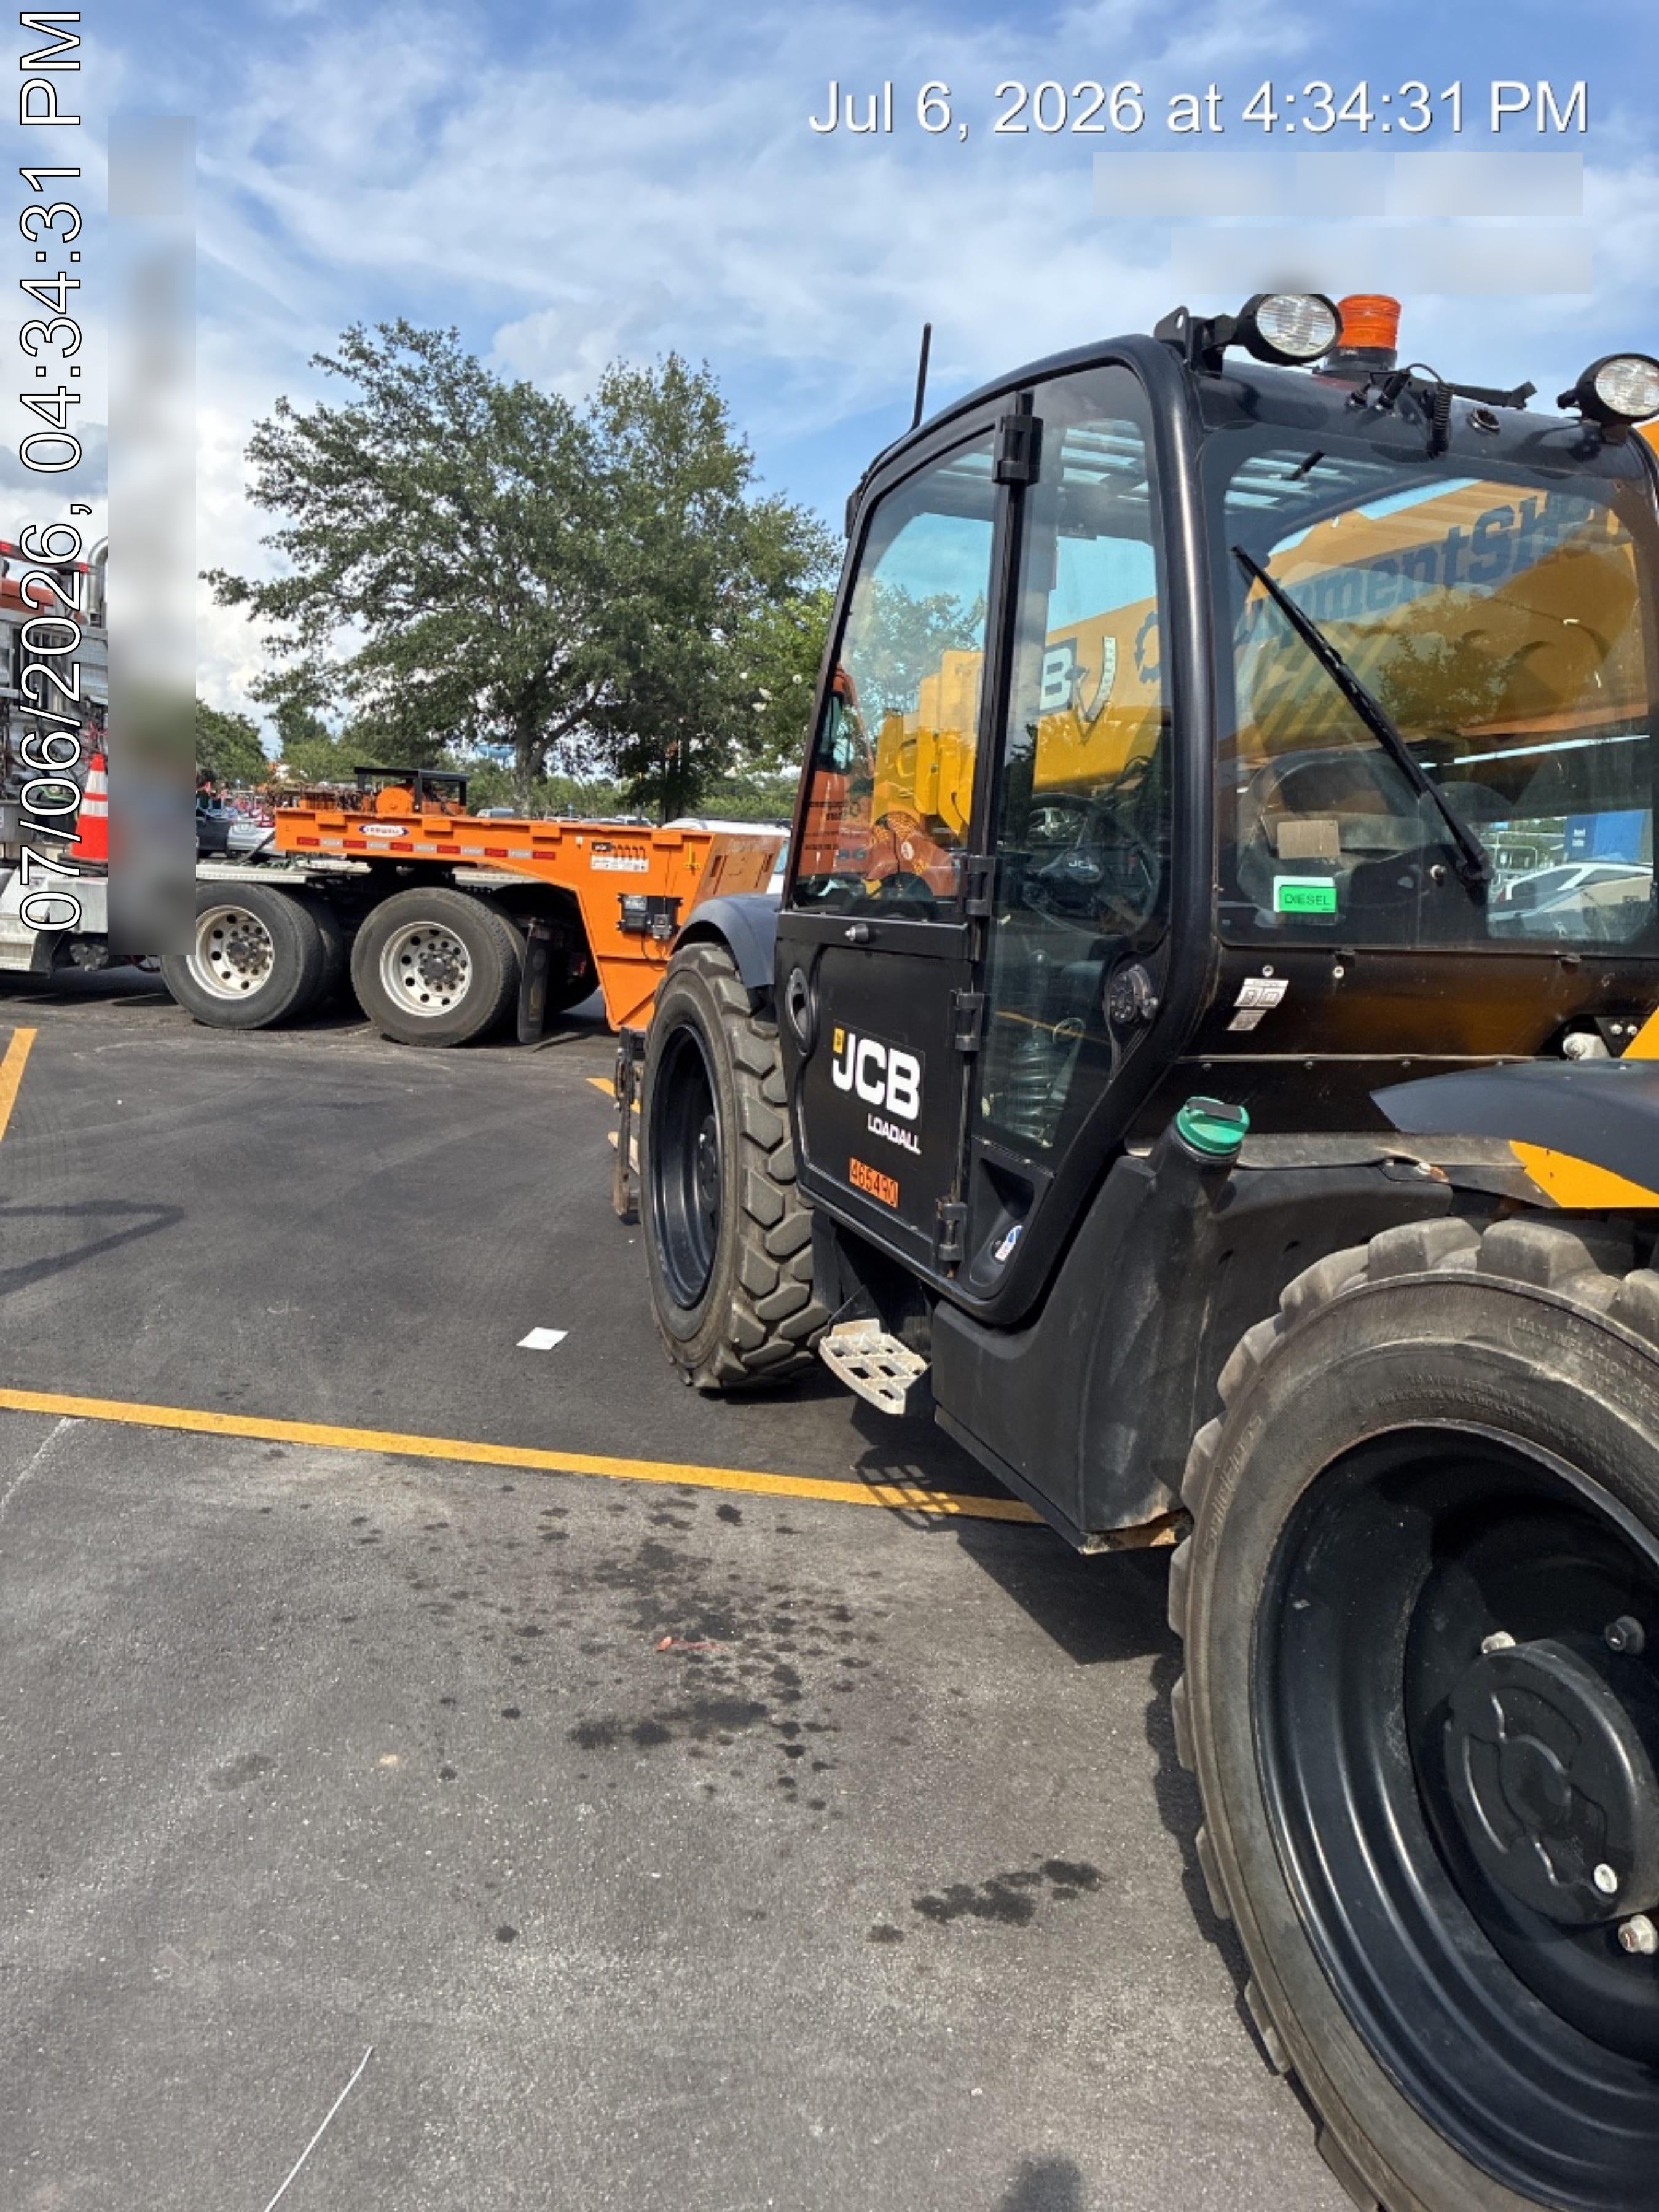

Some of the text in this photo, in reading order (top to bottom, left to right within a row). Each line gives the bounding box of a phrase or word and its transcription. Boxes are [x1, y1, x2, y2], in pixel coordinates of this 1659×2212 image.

[1284, 893, 1331, 906] DIESEL
[832, 1033, 921, 1121] JCB
[867, 1113, 922, 1155] LOADALL
[851, 1160, 896, 1206] 465490
